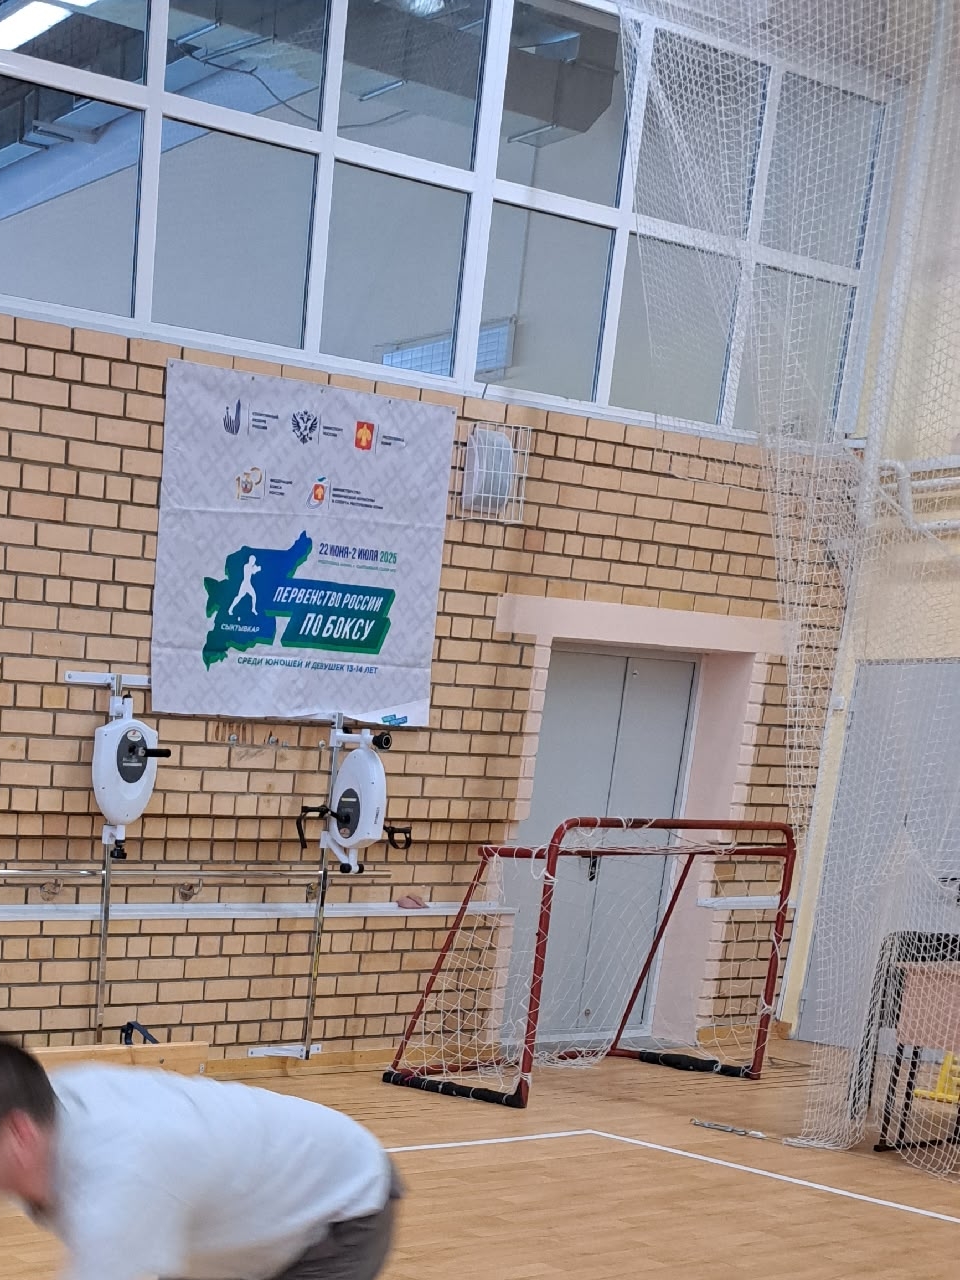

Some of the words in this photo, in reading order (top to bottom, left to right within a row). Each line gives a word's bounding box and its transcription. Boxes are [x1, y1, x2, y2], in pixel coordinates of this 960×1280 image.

[319, 542, 329, 555] 22
[357, 547, 379, 561] ИЮЛЯ
[379, 550, 398, 564] 2025
[272, 586, 343, 607] ПЕРВЕНСТВО
[341, 593, 384, 612] РОССИИ
[220, 623, 261, 633] СЫКТЫВКАР
[298, 612, 323, 637] ПО
[321, 615, 376, 641] БОКСУ
[237, 656, 264, 666] СРЕДИ
[264, 657, 304, 669] ЮНОШЕЙ
[311, 661, 345, 672] ДЕВУШЕК
[346, 664, 364, 674] 13-14
[364, 666, 379, 675] ЛЕТ
